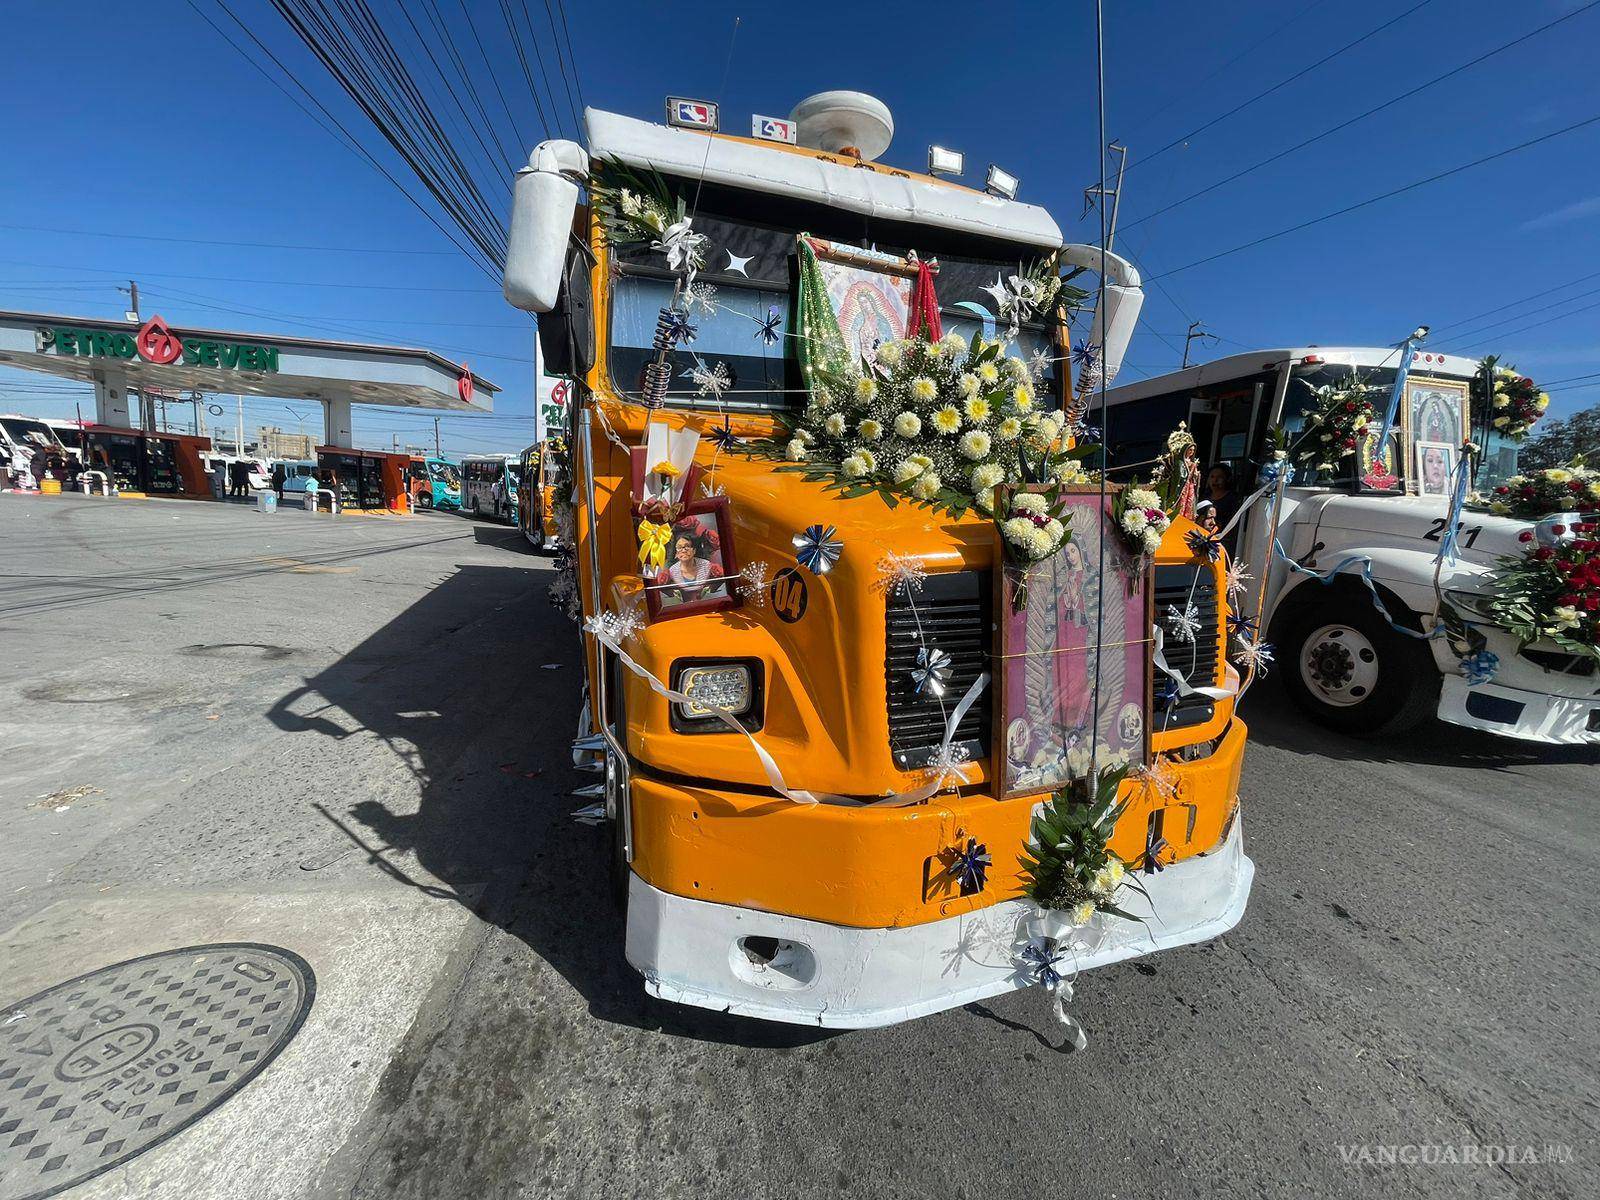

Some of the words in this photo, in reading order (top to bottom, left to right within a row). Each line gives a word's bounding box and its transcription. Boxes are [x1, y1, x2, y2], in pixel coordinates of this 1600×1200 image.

[35, 327, 139, 358] PETRO
[183, 340, 279, 374] SEVEN
[1423, 518, 1483, 549] 21
[774, 574, 803, 619] 04
[69, 1031, 145, 1074] CFE
[81, 1039, 189, 1103] FUNDES
